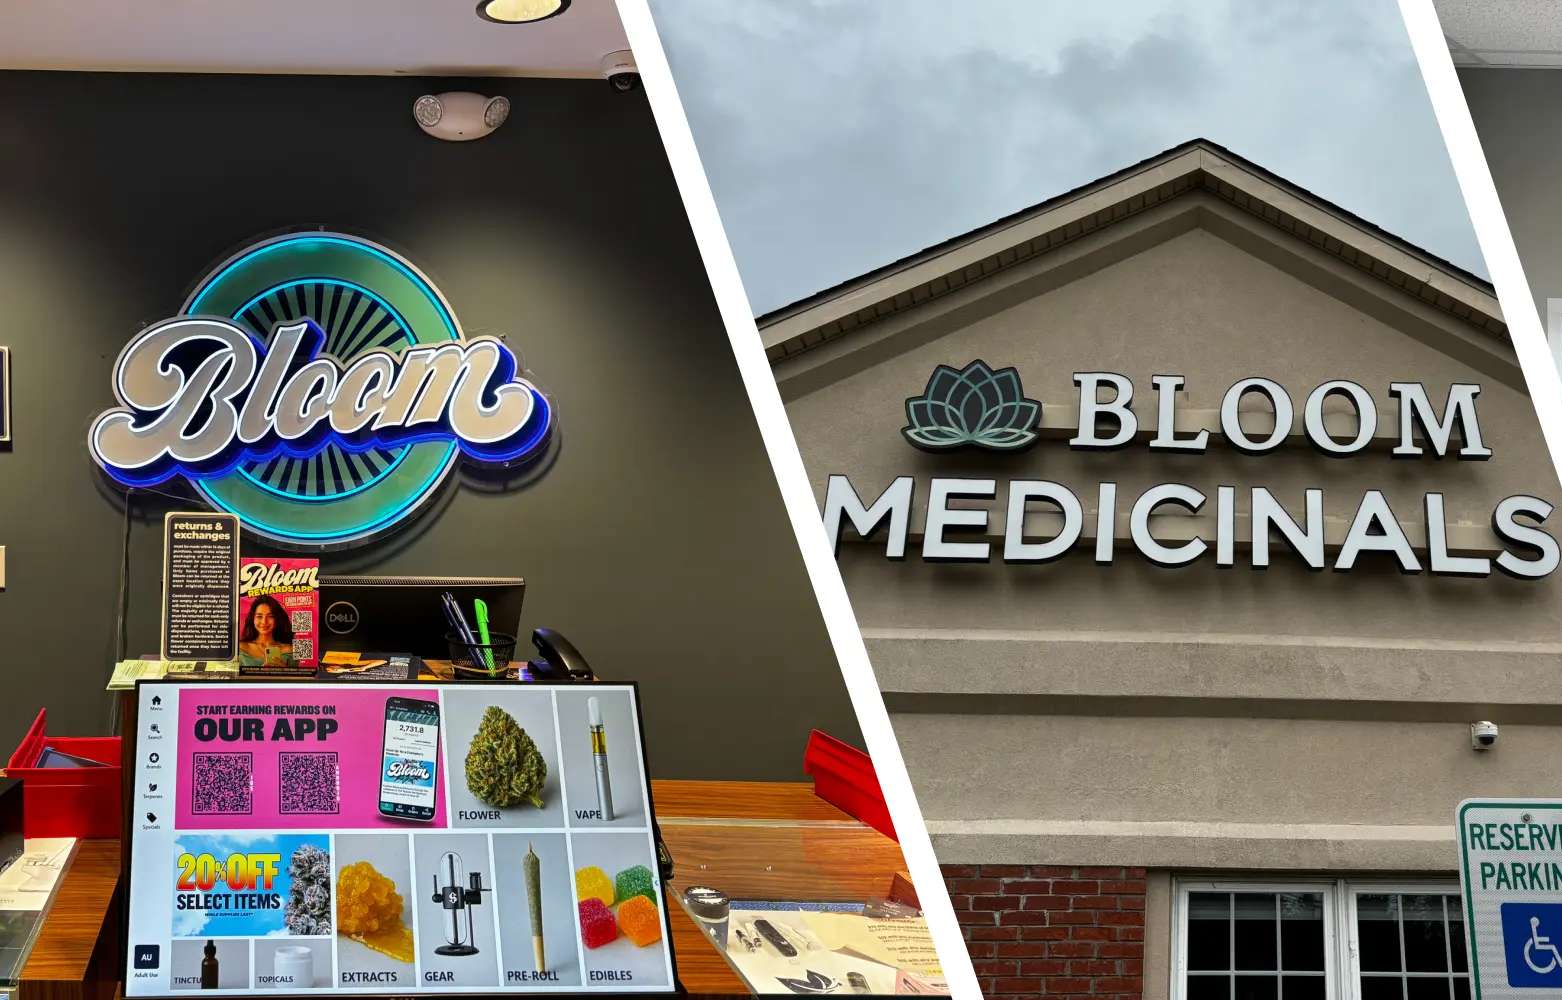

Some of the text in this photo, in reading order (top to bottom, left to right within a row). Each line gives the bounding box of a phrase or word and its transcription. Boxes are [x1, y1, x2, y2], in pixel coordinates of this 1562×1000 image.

[88, 316, 538, 472] Bloom
[1069, 371, 1493, 460] BLOOM
[174, 522, 223, 530] returns &
[824, 473, 1562, 579] MEDICINALS
[174, 531, 231, 542] exchanges
[240, 562, 320, 594] Bloom
[248, 586, 294, 598] REWARDS
[330, 614, 355, 622] DELL
[197, 705, 336, 715] START EARNING REWARDS ON
[194, 718, 338, 742] OUR APP
[400, 724, 424, 734] 2,731.8
[387, 762, 430, 780] Bloom
[459, 810, 500, 820] FLOWER
[576, 810, 601, 820] VAPE
[176, 894, 281, 910] SELECT ITEMS
[342, 972, 397, 982] EXTRACTS
[424, 971, 454, 982] GEAR
[507, 971, 559, 981] PRE-ROLL
[590, 970, 633, 981] EDIBLES
